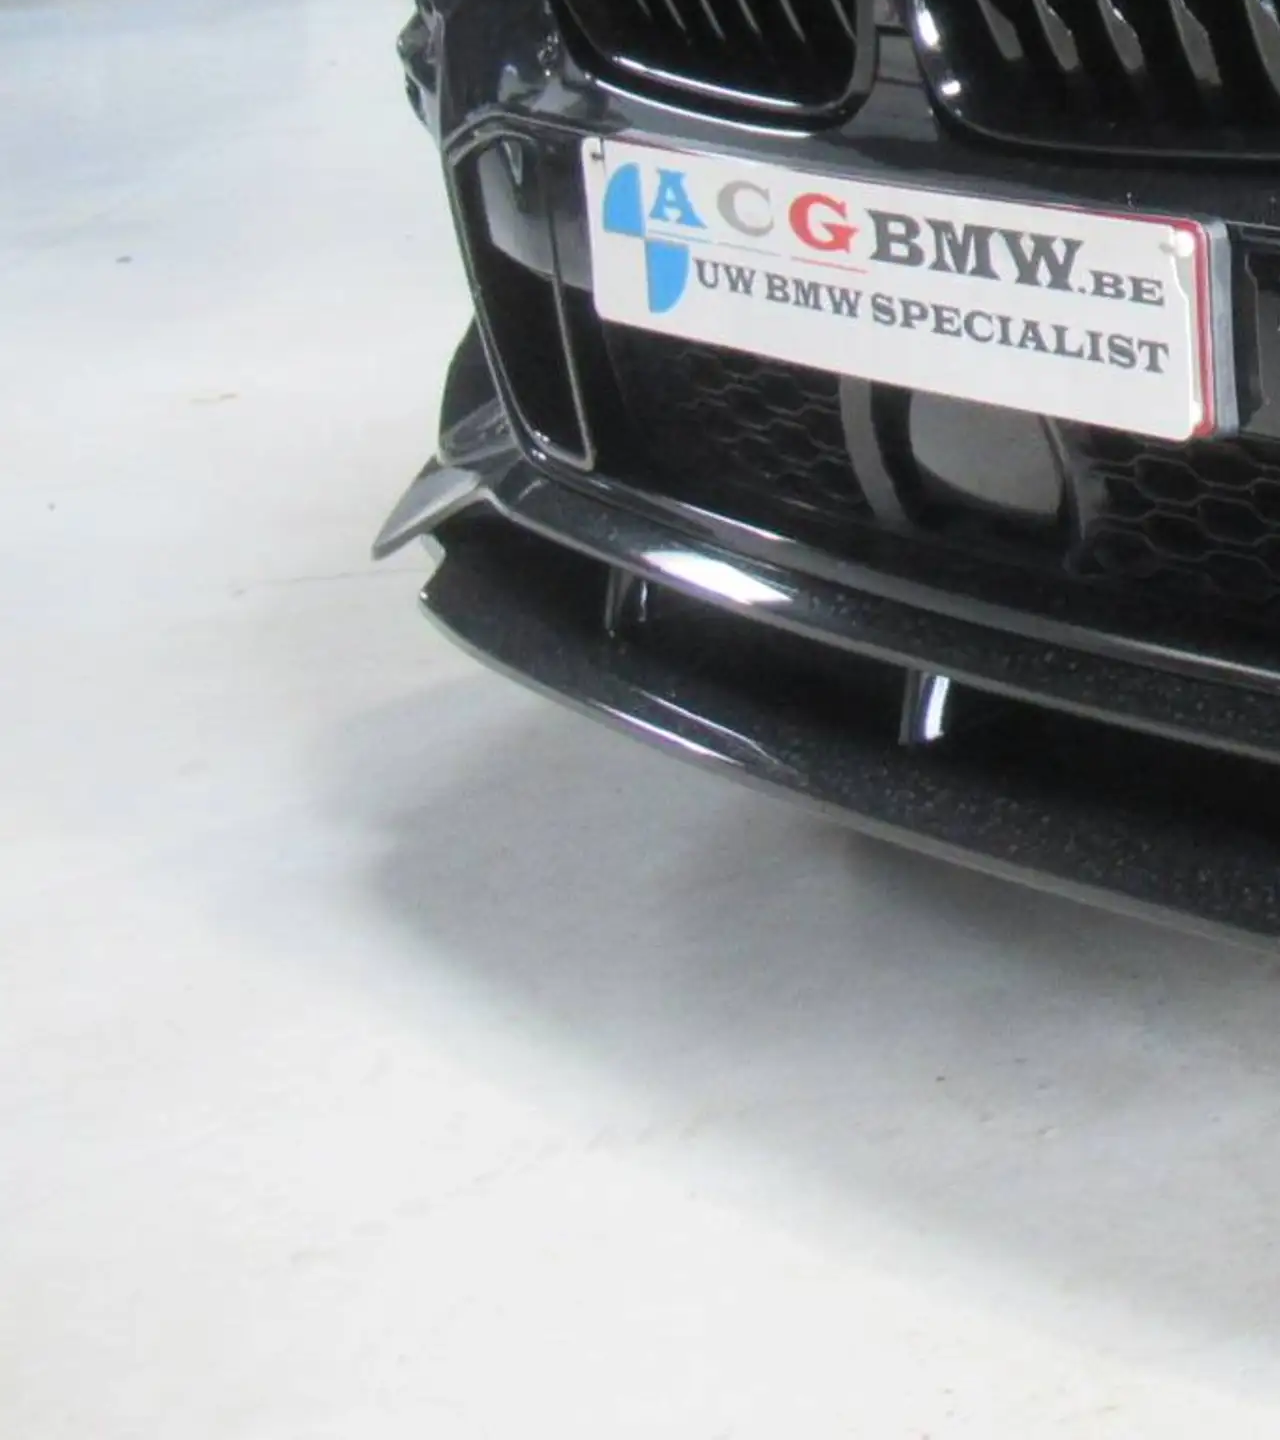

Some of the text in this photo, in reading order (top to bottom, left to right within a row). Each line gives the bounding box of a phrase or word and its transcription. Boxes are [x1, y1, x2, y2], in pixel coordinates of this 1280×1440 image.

[692, 257, 1170, 374] UW BMW SPECIALIST
